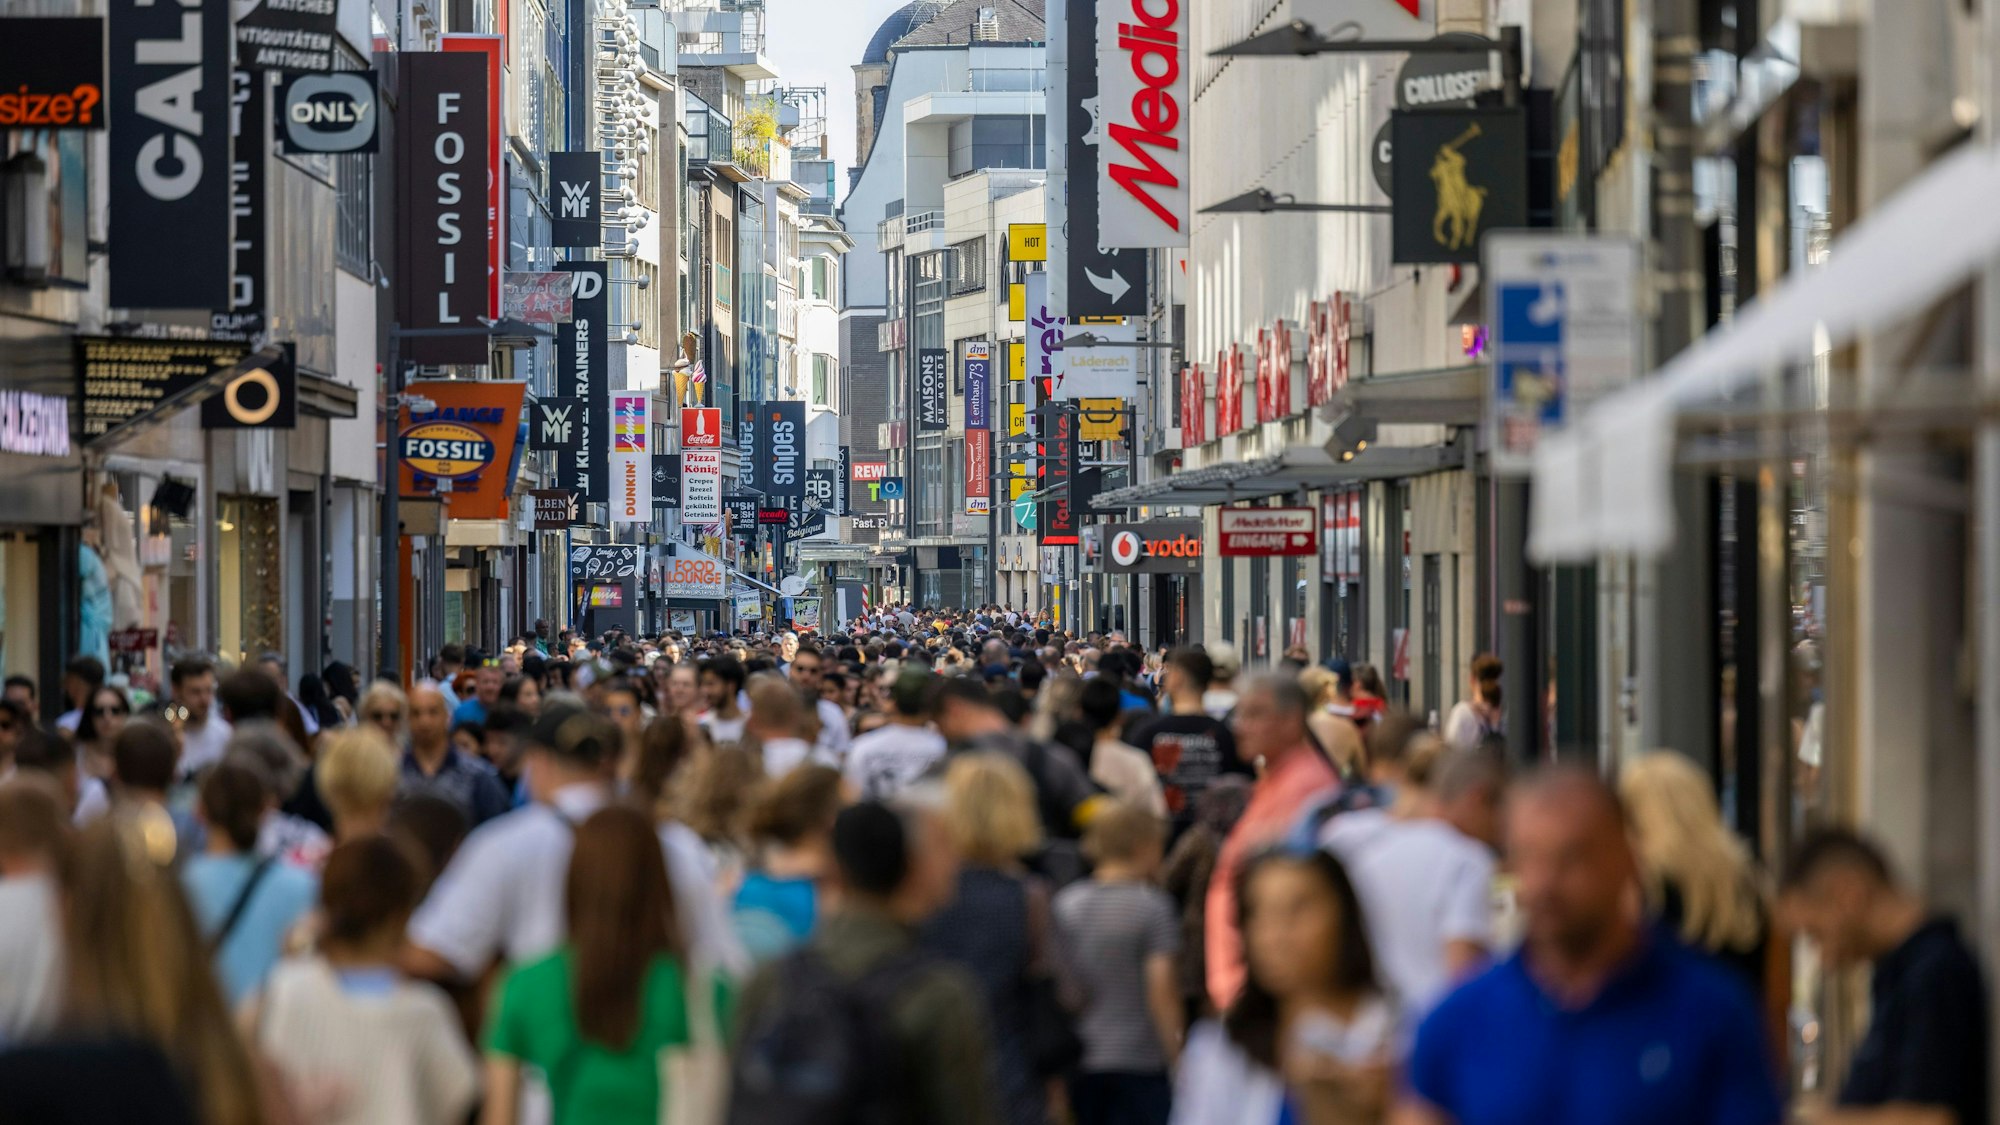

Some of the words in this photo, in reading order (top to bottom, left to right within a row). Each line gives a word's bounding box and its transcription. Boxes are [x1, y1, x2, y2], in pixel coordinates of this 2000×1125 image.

[256, 48, 330, 70] ANTIQUES
[0, 84, 101, 124] size?
[135, 0, 204, 201] CAL
[291, 102, 369, 123] ONLY
[560, 181, 591, 218] WMF
[434, 93, 465, 323] FOSSIL
[1024, 237, 1040, 248] HOT
[532, 300, 567, 312] ART
[970, 344, 986, 354] dm
[1020, 357, 1025, 366] F
[1072, 355, 1129, 366] Läderach
[969, 363, 984, 380] 73
[922, 355, 934, 423] MAISONS
[540, 405, 572, 443] WMF
[938, 409, 945, 424] DU
[1014, 417, 1024, 427] CH
[621, 399, 643, 452] jamin
[405, 439, 486, 460] FOSSIL
[1053, 414, 1068, 476] Locke
[686, 454, 716, 462] Pizza
[773, 422, 800, 485] snipes
[684, 465, 718, 475] König
[626, 460, 636, 516] DUNKIN'
[971, 500, 986, 509] dm
[534, 511, 565, 520] WALD
[1052, 496, 1070, 530] Foo
[852, 518, 876, 528] Fast.
[787, 524, 822, 539] Belgique
[1228, 533, 1287, 550] EINGANG
[596, 547, 618, 559] Candy!
[675, 559, 715, 572] FOOD
[668, 571, 721, 584] LOUNGE
